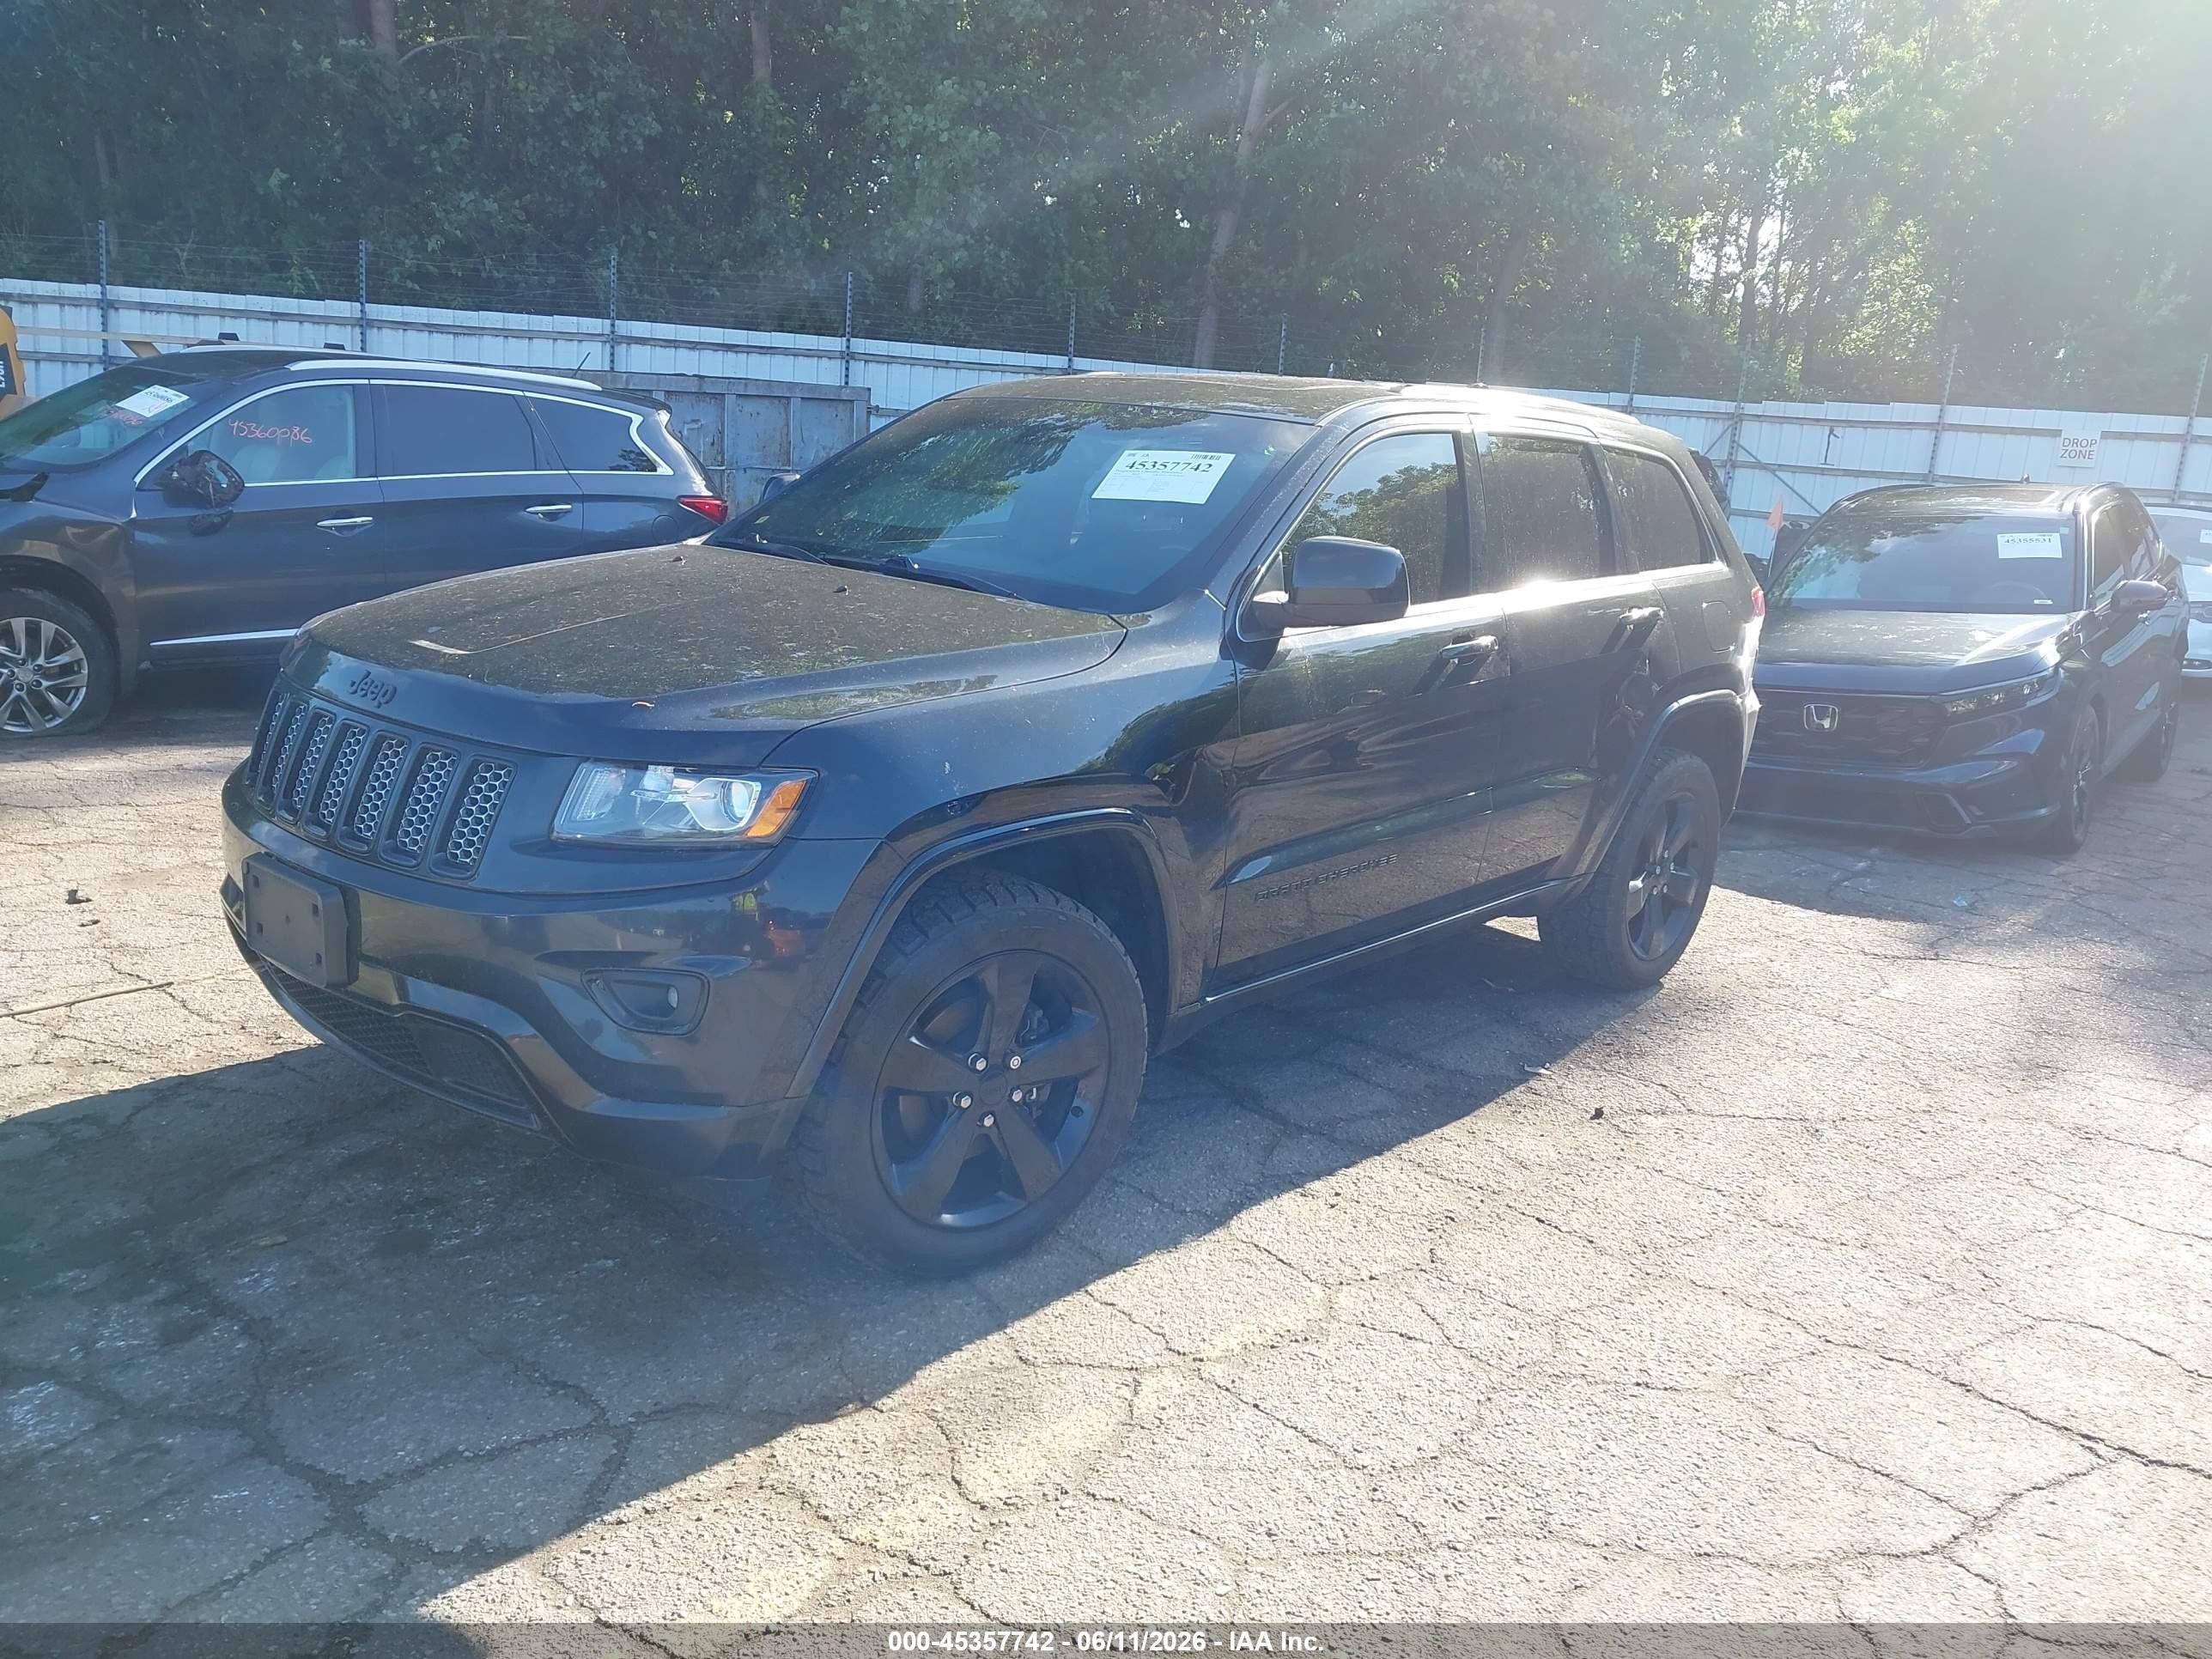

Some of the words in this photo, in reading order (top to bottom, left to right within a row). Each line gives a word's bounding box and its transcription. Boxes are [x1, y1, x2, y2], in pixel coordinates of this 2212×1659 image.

[2063, 438, 2097, 447] DROP
[2061, 449, 2094, 459] ZONE
[1125, 460, 1212, 472] 45357742
[347, 670, 397, 708] Jeep
